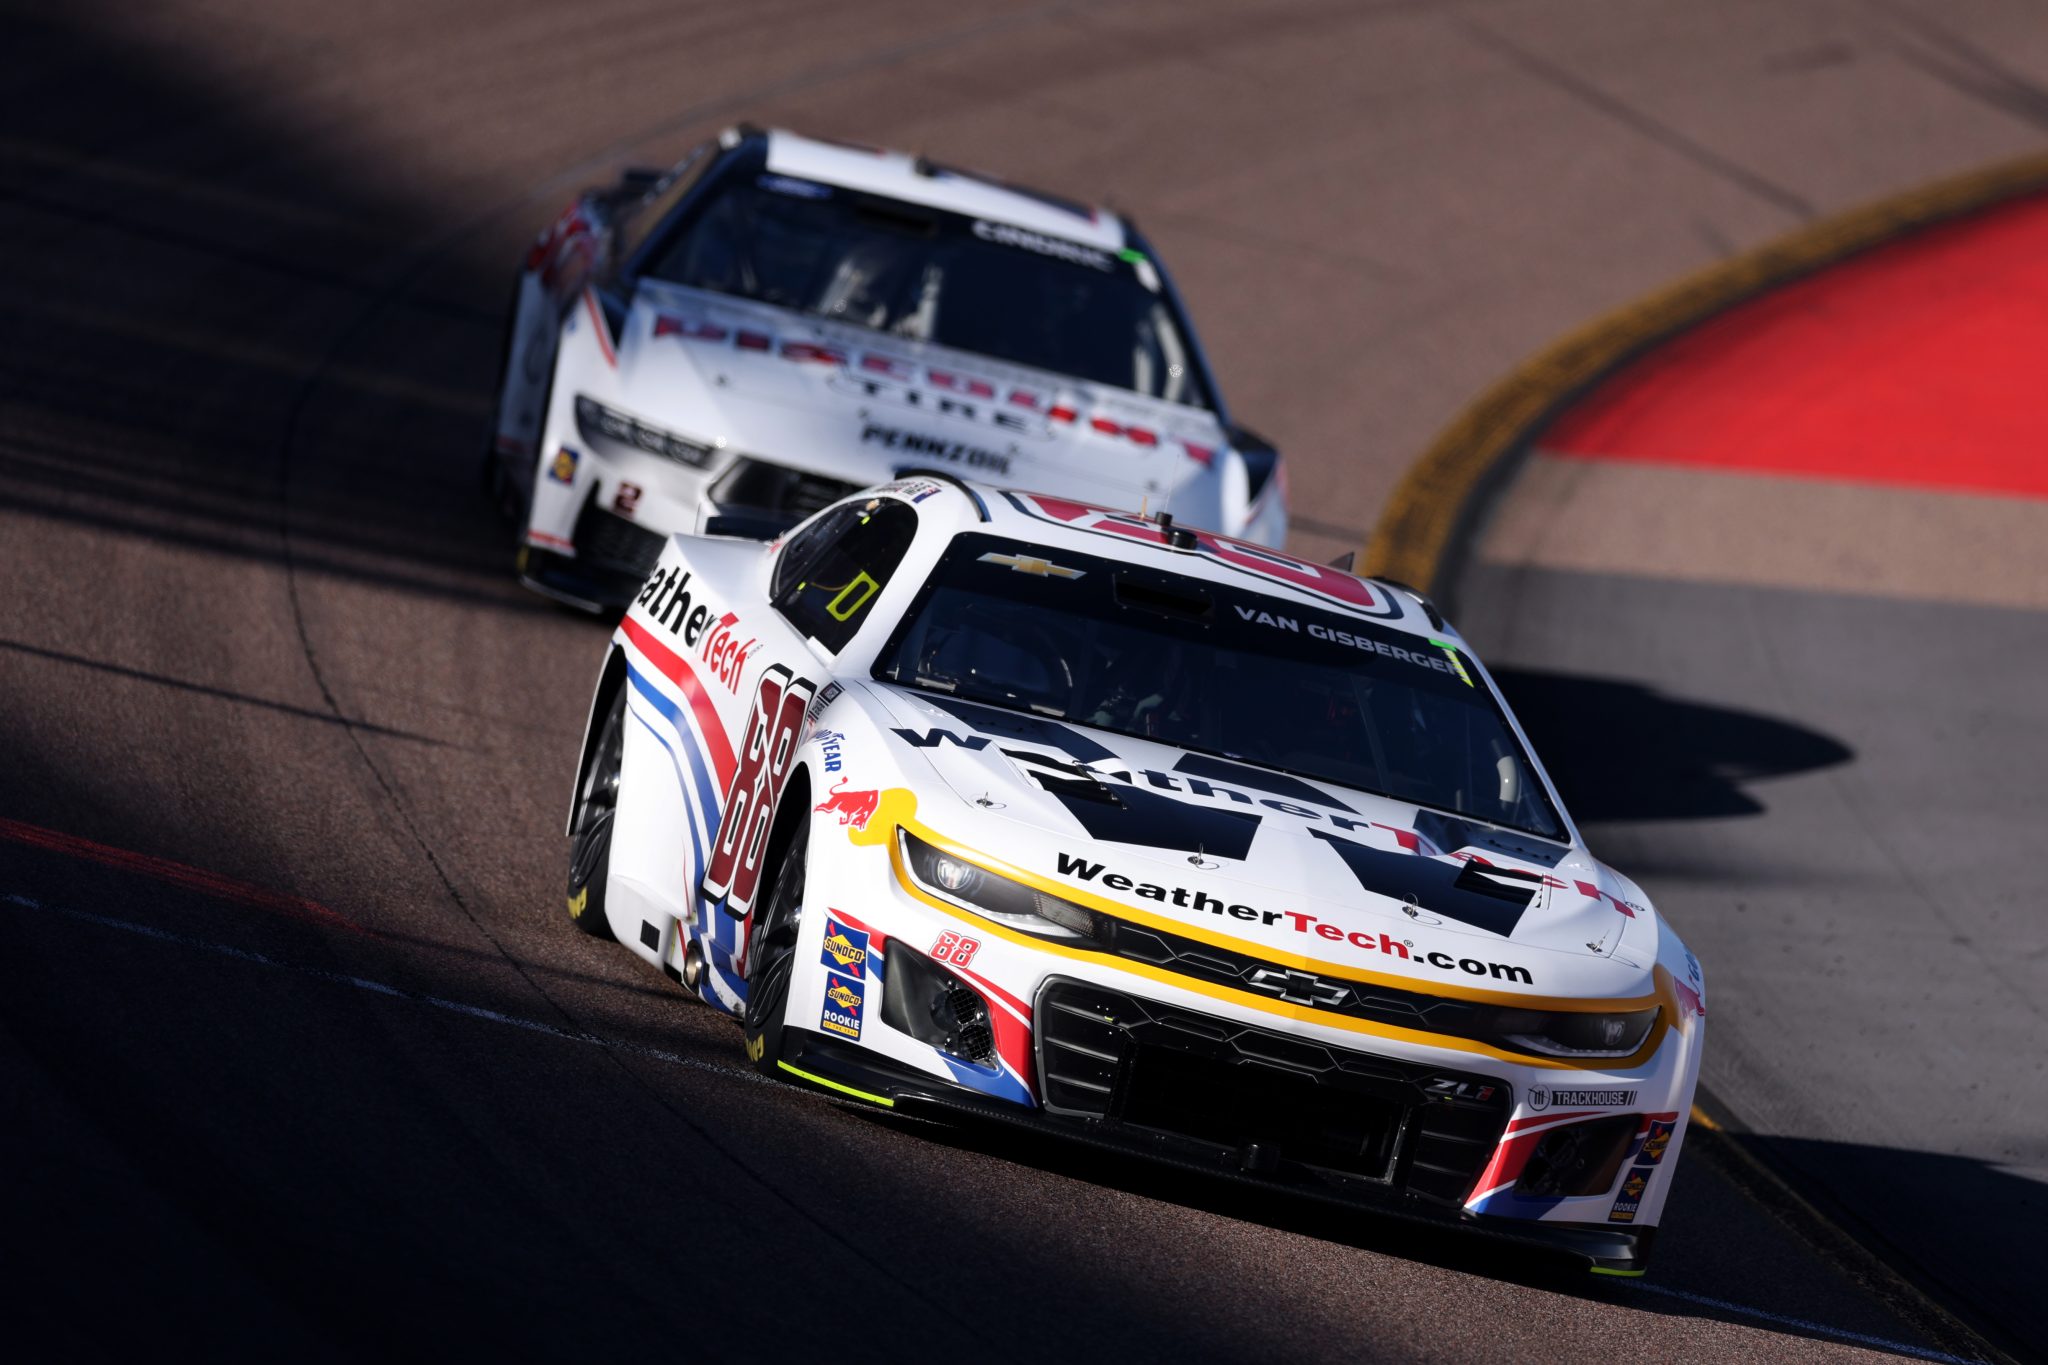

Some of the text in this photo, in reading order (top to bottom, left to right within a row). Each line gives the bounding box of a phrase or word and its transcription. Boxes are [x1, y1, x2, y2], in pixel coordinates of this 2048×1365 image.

[611, 480, 643, 519] 2
[1233, 605, 1299, 633] VAN
[700, 662, 818, 922] 88
[824, 937, 865, 963] SUNOCO
[929, 929, 981, 969] 88
[828, 988, 861, 1007] SUNOCO
[824, 1009, 861, 1030] ROOKIE
[1555, 1090, 1625, 1106] TRACKHOUSE
